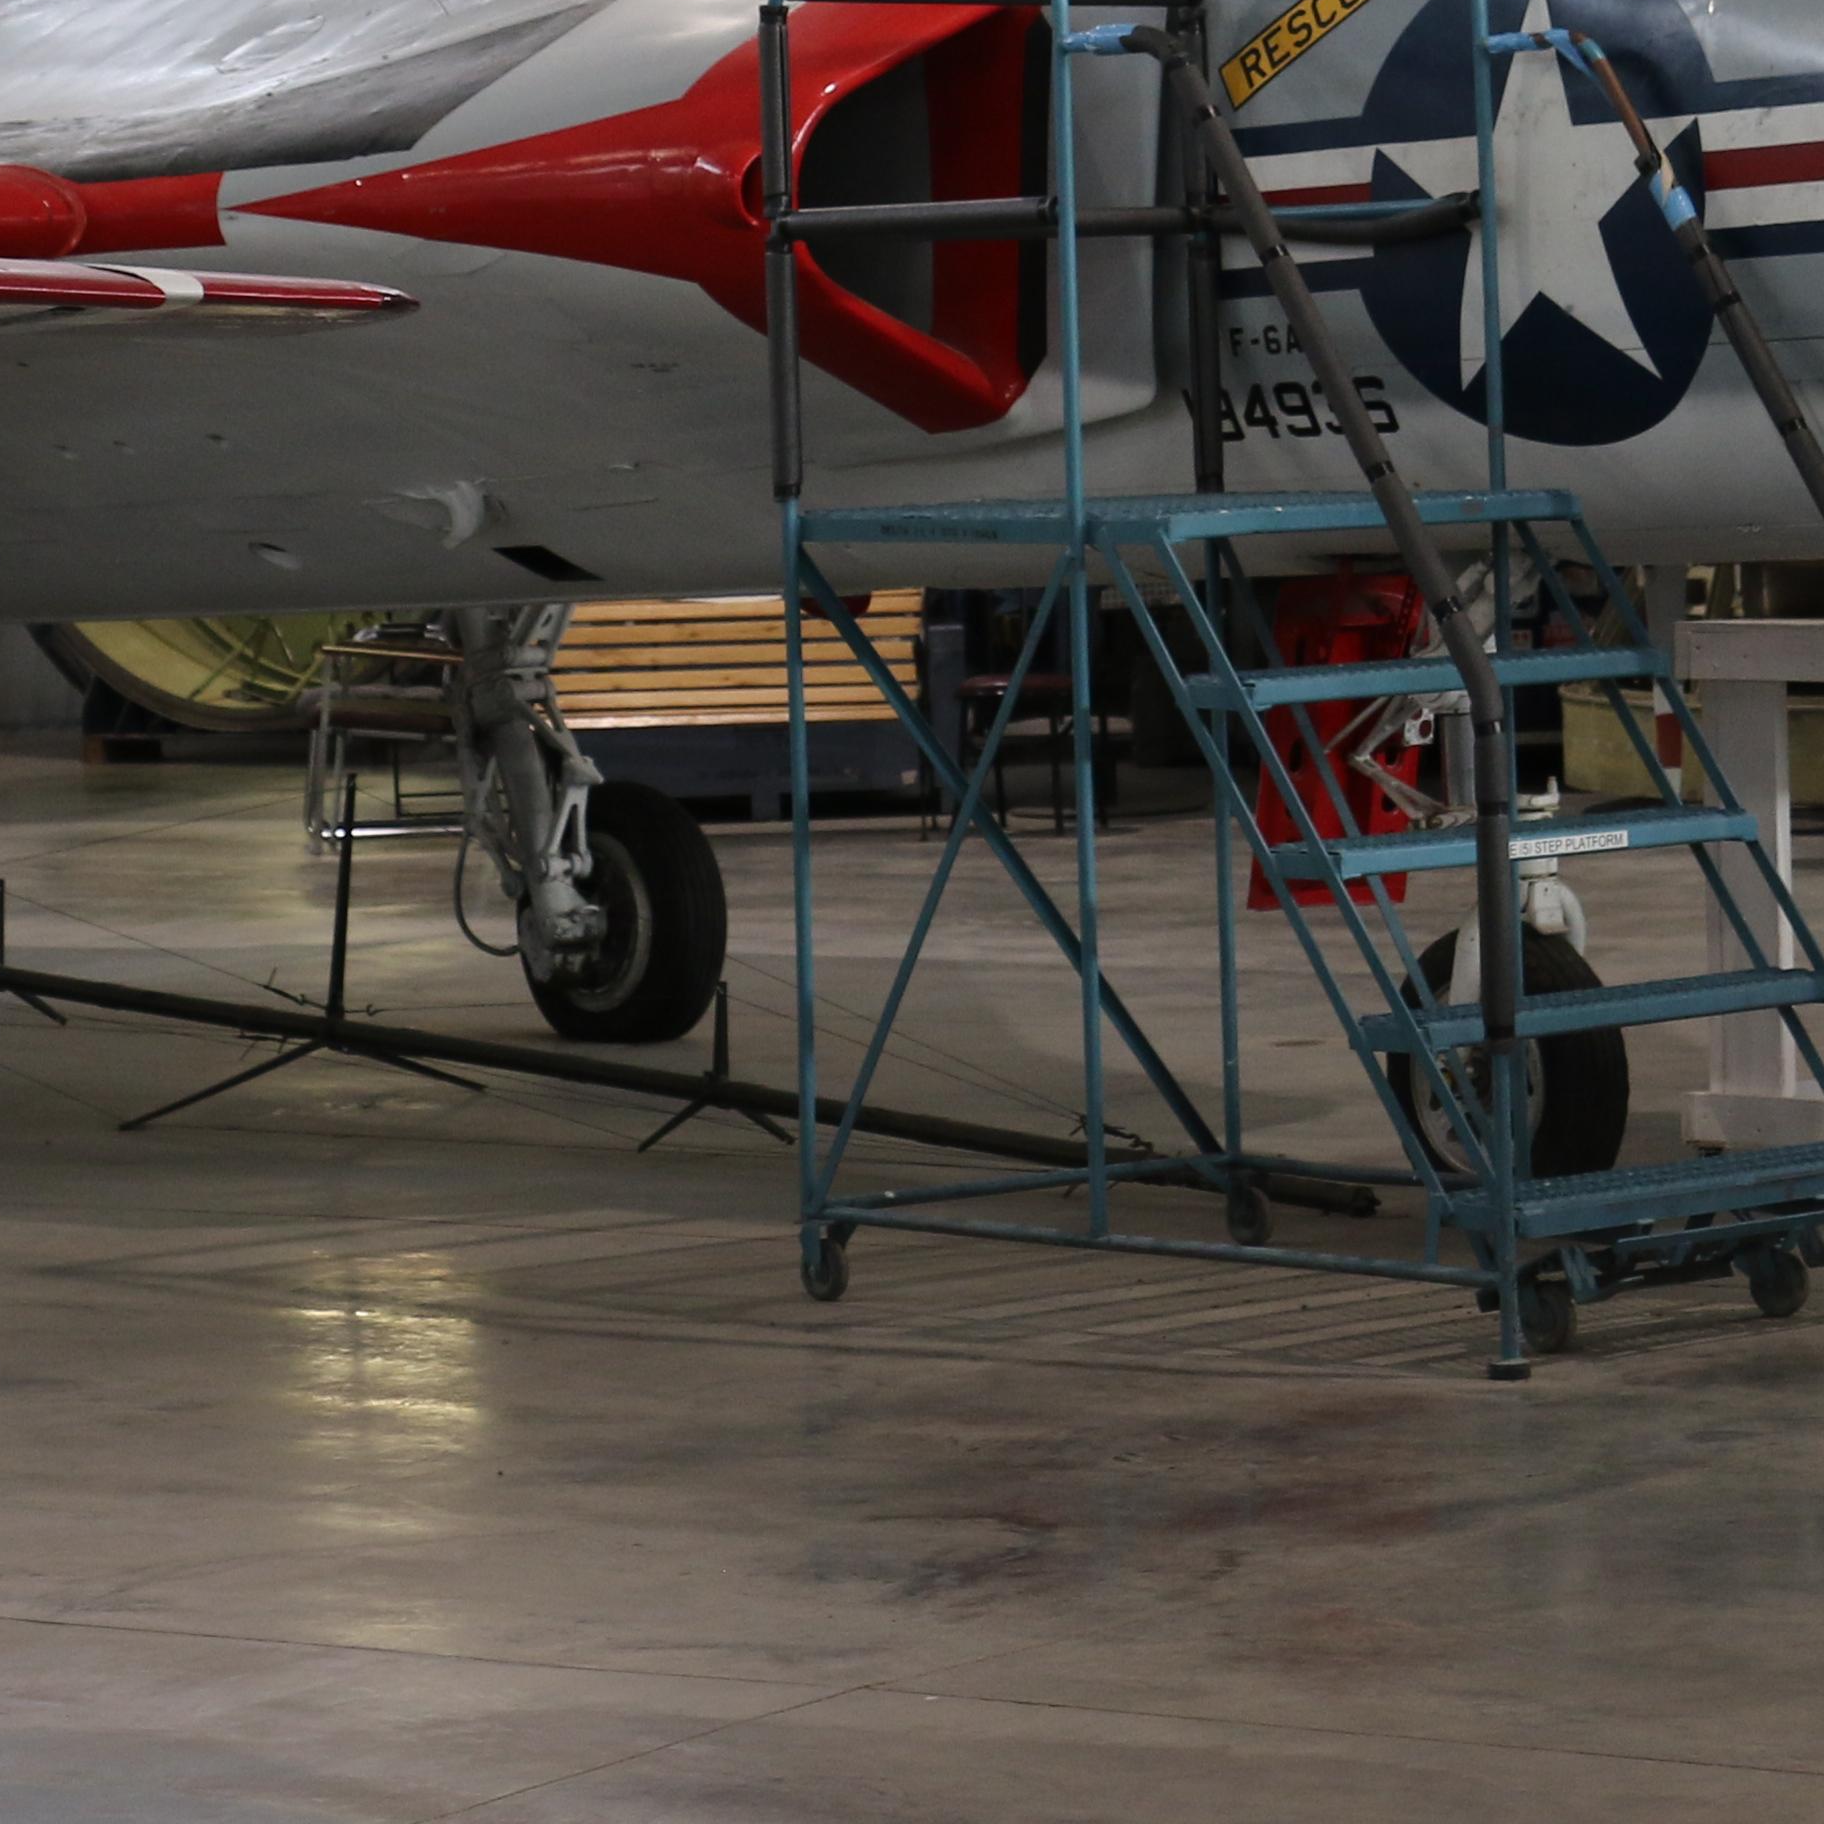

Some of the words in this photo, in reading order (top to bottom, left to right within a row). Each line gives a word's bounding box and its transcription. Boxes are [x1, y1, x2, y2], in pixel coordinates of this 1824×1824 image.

[1229, 324, 1303, 358] F-6A
[1535, 839, 1563, 854] STEP
[1565, 832, 1624, 850] PLATFORM
